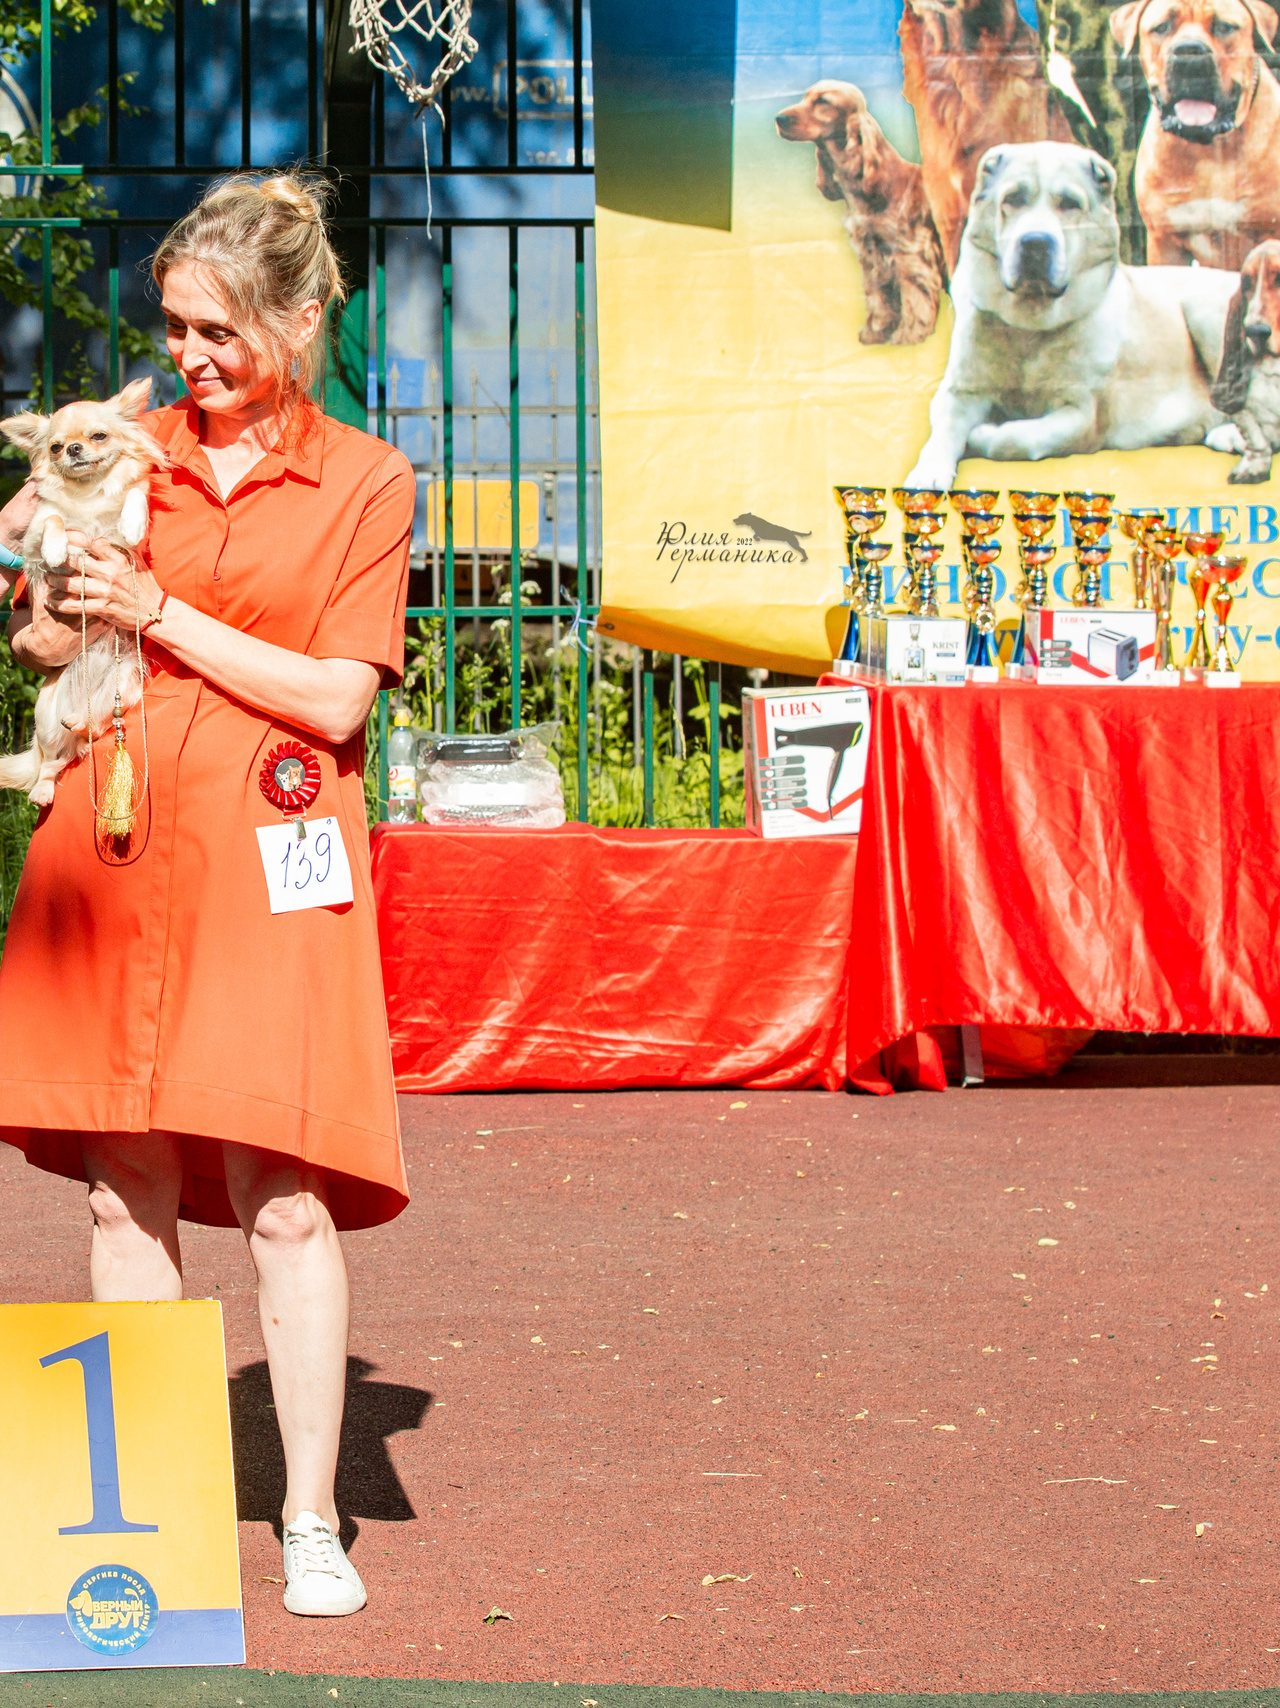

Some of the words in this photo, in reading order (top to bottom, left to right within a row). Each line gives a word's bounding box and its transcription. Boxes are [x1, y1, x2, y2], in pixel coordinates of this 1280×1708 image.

[770, 701, 822, 718] LEBEN
[281, 833, 332, 890] 139
[39, 1331, 158, 1536] 1
[82, 1571, 118, 1589] СЕРГИЕВ
[121, 1572, 146, 1596] ПОСАД
[89, 1611, 144, 1630] ДРУГ
